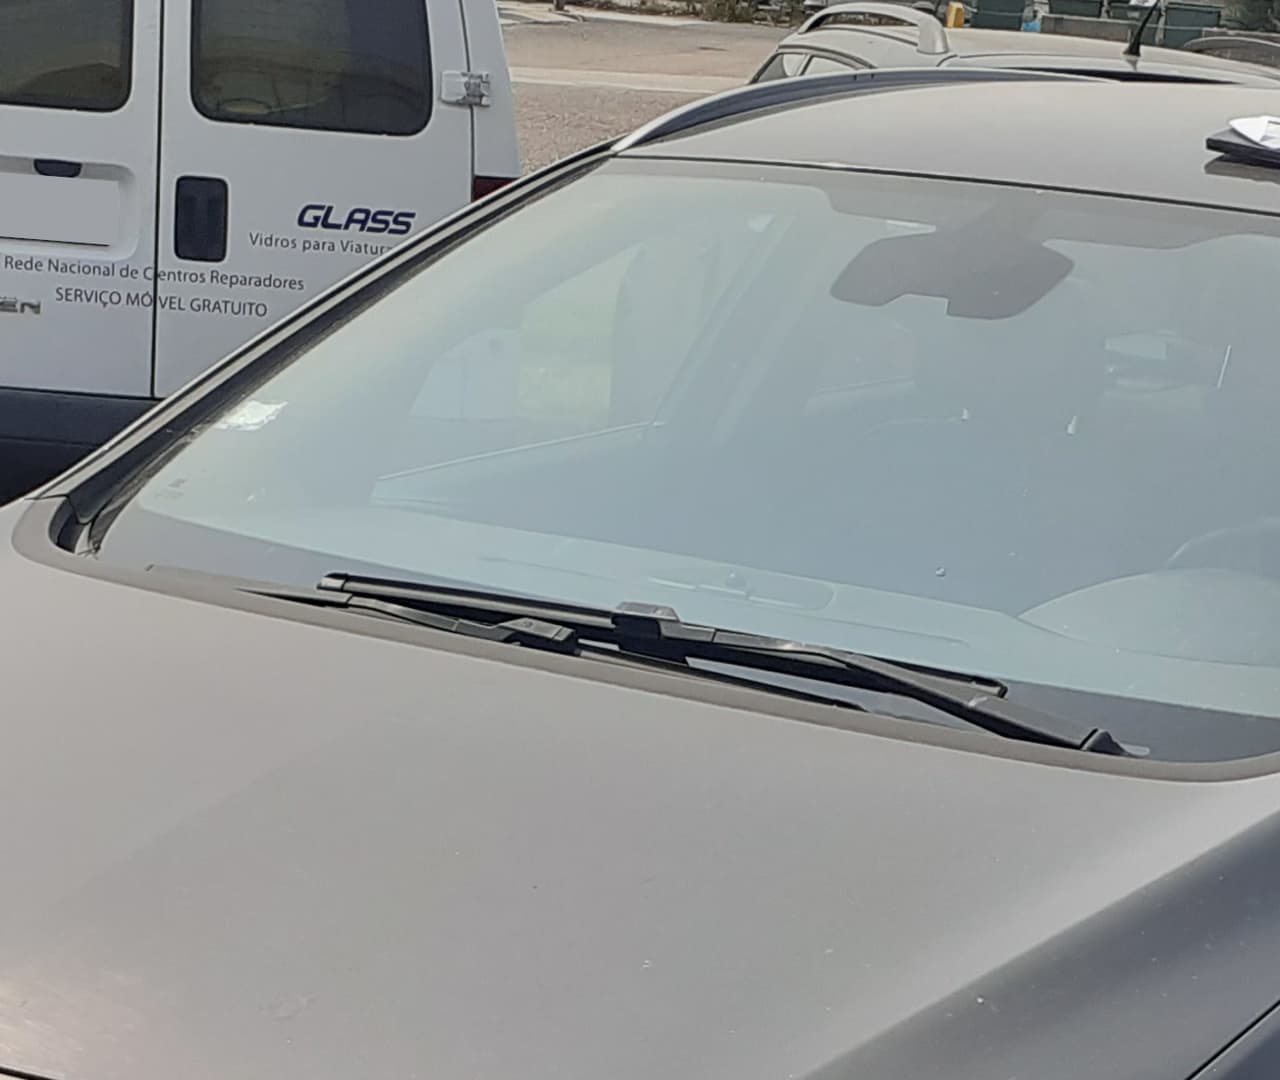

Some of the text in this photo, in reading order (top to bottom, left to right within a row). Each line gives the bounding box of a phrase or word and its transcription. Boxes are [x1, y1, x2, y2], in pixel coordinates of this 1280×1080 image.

[298, 204, 416, 235] GLASS
[249, 232, 297, 249] Vidros
[302, 239, 335, 252] para
[4, 255, 305, 290] Rede Nacional de Centros Reparadores
[56, 287, 121, 309] SERVIÇO
[190, 297, 267, 317] GRATUITO
